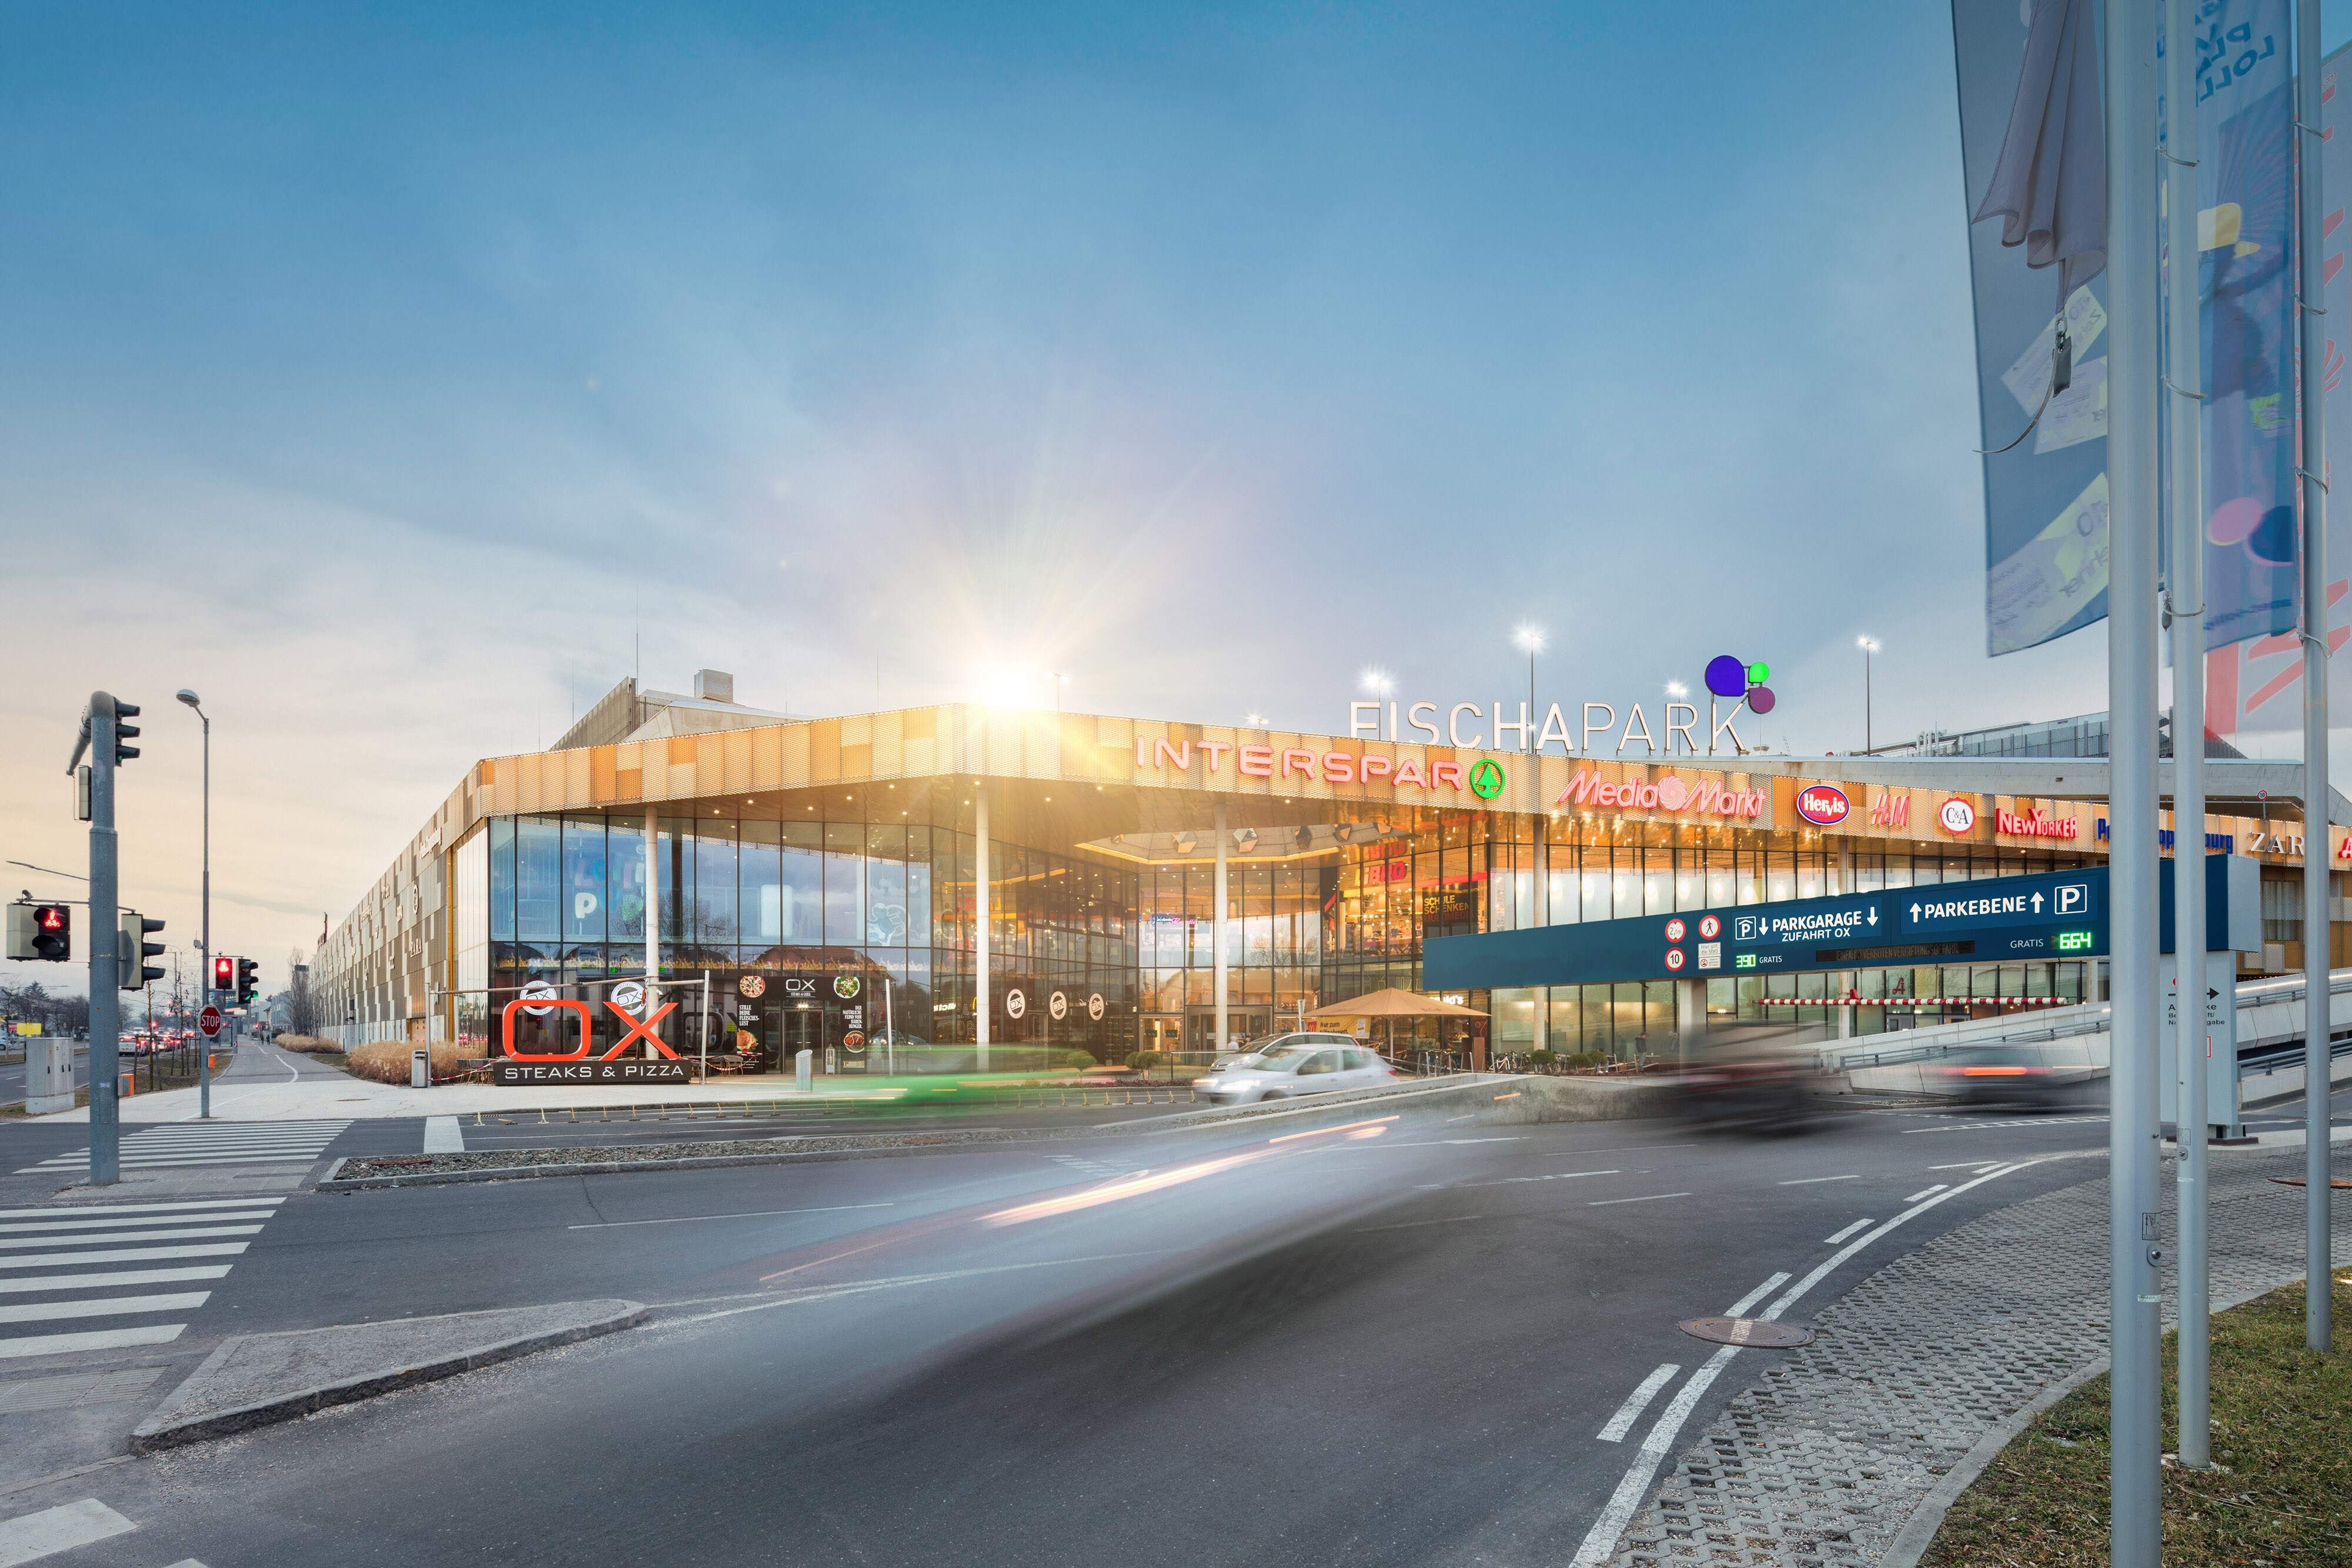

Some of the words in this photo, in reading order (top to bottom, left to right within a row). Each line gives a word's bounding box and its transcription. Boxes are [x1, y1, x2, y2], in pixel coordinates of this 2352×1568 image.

[1350, 700, 1746, 752] FISCHAPARK
[1137, 735, 1463, 791] INTERSPAR
[1556, 768, 1659, 809] Media
[1682, 778, 1766, 818] Markt
[1804, 793, 1845, 816] Hervis
[1872, 794, 1912, 827] H&M
[1946, 807, 1970, 824] C&A
[2249, 831, 2306, 855] ZAR
[1925, 895, 2026, 919] PARKEBENE
[2062, 887, 2080, 912] P
[1772, 911, 1862, 932] PARKGARAGE
[1742, 924, 1750, 937] P
[1782, 928, 1832, 942] ZUFAHRT
[1834, 927, 1850, 938] OX
[2010, 938, 2044, 949] GRATIS
[2060, 932, 2092, 950] 664
[1671, 954, 1680, 965] 10
[1736, 954, 1756, 968] 390
[1759, 955, 1782, 964] GRATIS
[786, 979, 816, 991] OX
[617, 991, 643, 1005] OX
[1010, 999, 1023, 1009] OX
[1053, 1001, 1065, 1011] OX
[1091, 1003, 1102, 1011] OX
[201, 1015, 220, 1027] STOP
[502, 999, 680, 1062] OX
[505, 1066, 592, 1079] STEAKS
[602, 1066, 616, 1077] &
[625, 1065, 684, 1076] PIZZA
